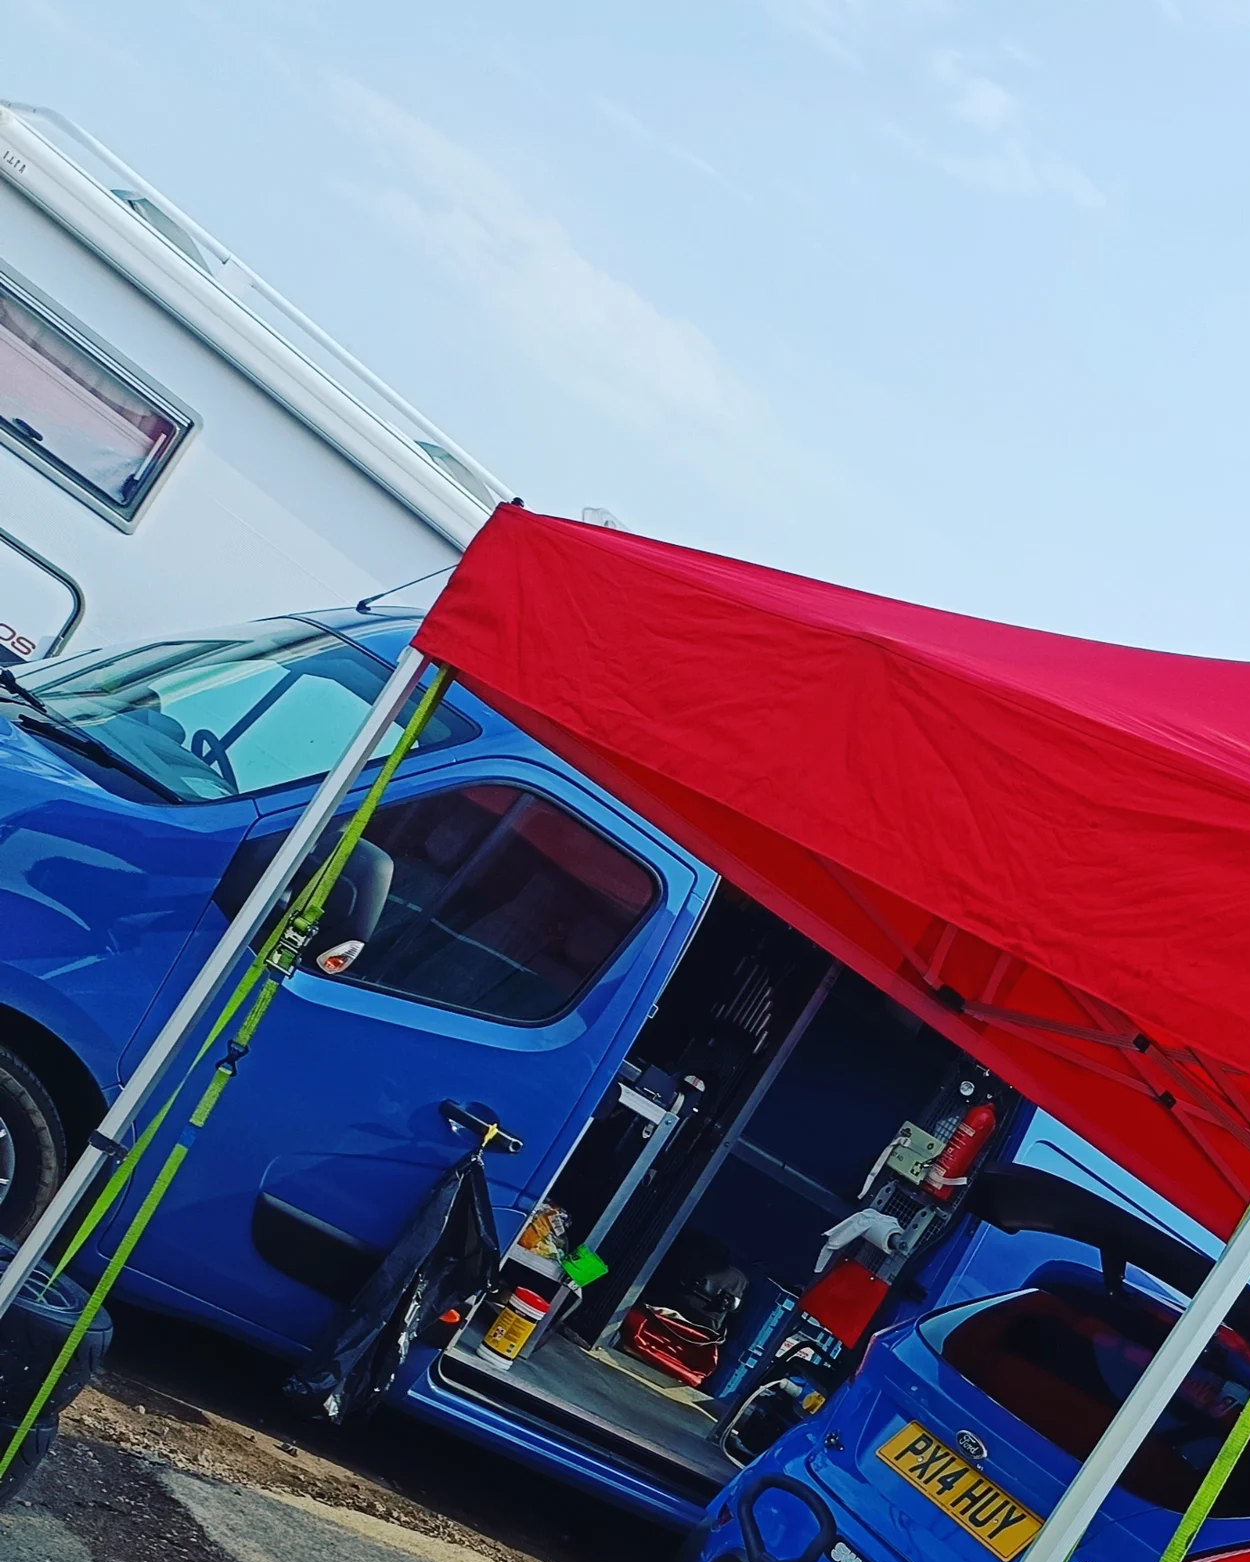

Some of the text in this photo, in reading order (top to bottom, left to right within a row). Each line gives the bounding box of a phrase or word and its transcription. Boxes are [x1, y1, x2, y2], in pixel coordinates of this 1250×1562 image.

[958, 1433, 980, 1456] Ford
[893, 1433, 1027, 1540] PX14 HUY
